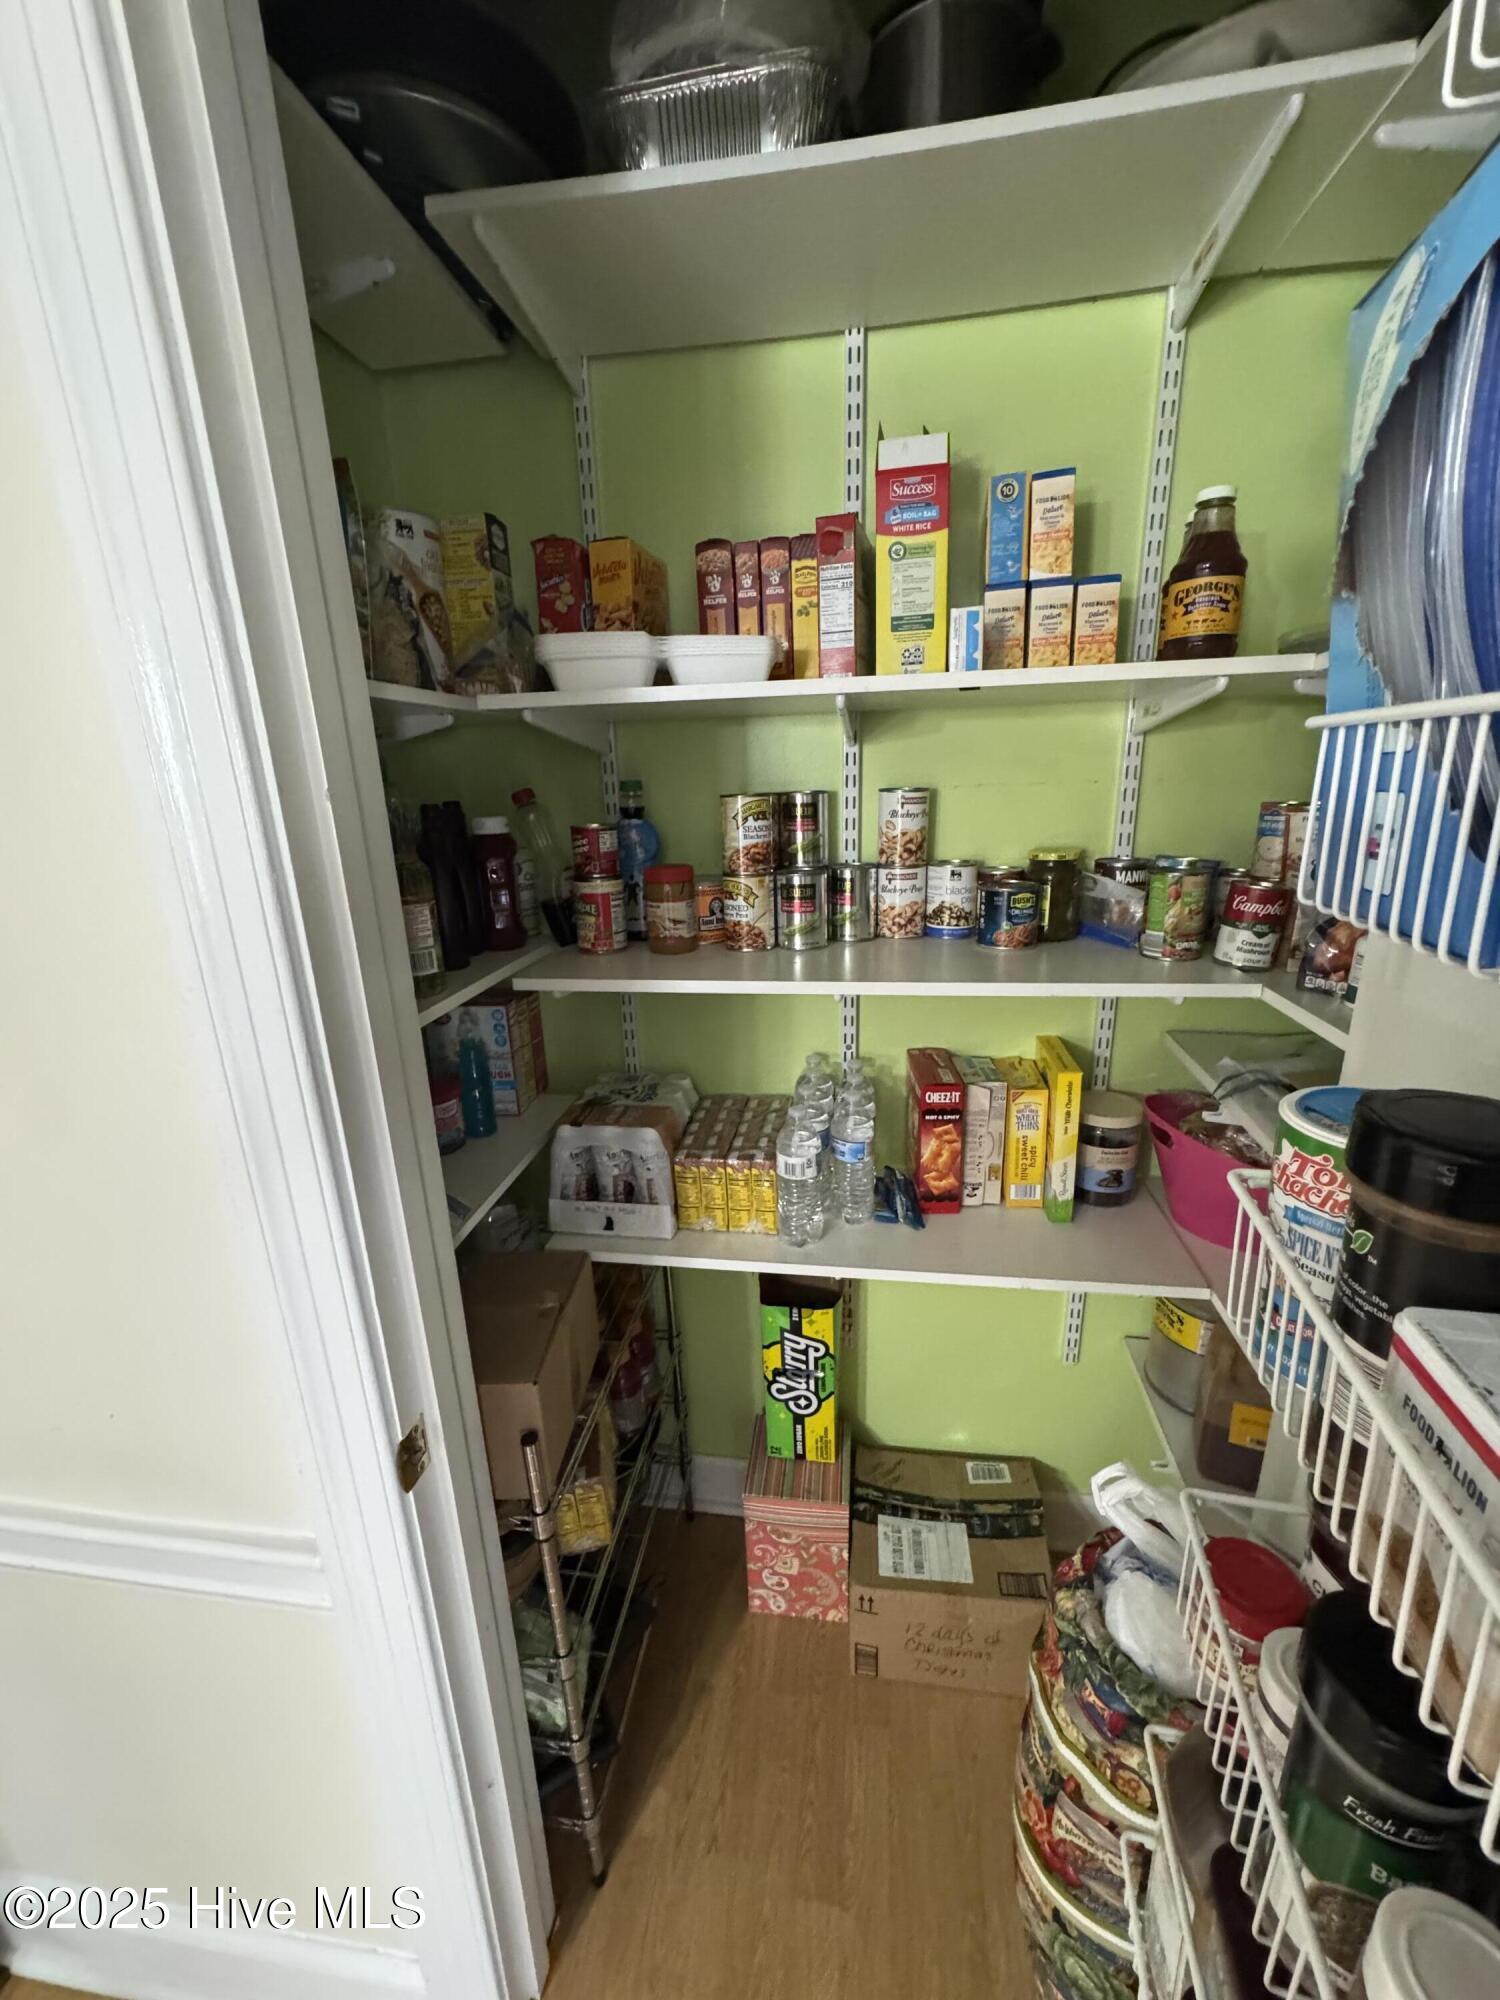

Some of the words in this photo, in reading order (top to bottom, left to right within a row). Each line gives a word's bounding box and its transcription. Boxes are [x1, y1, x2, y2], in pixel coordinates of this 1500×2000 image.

[891, 482, 933, 497] Success
[1002, 485, 1013, 496] 10
[893, 524, 914, 533] WHITE
[916, 522, 932, 531] RICE
[738, 591, 757, 599] HELPER
[1174, 581, 1240, 607] GEORGE'S
[1241, 940, 1263, 948] Cream
[1016, 1114, 1040, 1122] WHEAT
[1016, 1121, 1040, 1131] THINS
[1028, 1145, 1037, 1168] spicy
[1020, 1162, 1028, 1181] chili
[1286, 1227, 1320, 1265] SPICE
[770, 1332, 826, 1415] Starry
[1403, 1394, 1434, 1446] FOOD
[1453, 1464, 1489, 1515] LION
[905, 1623, 926, 1637] 12
[931, 1624, 974, 1649] days
[1343, 1795, 1396, 1834] Fresh
